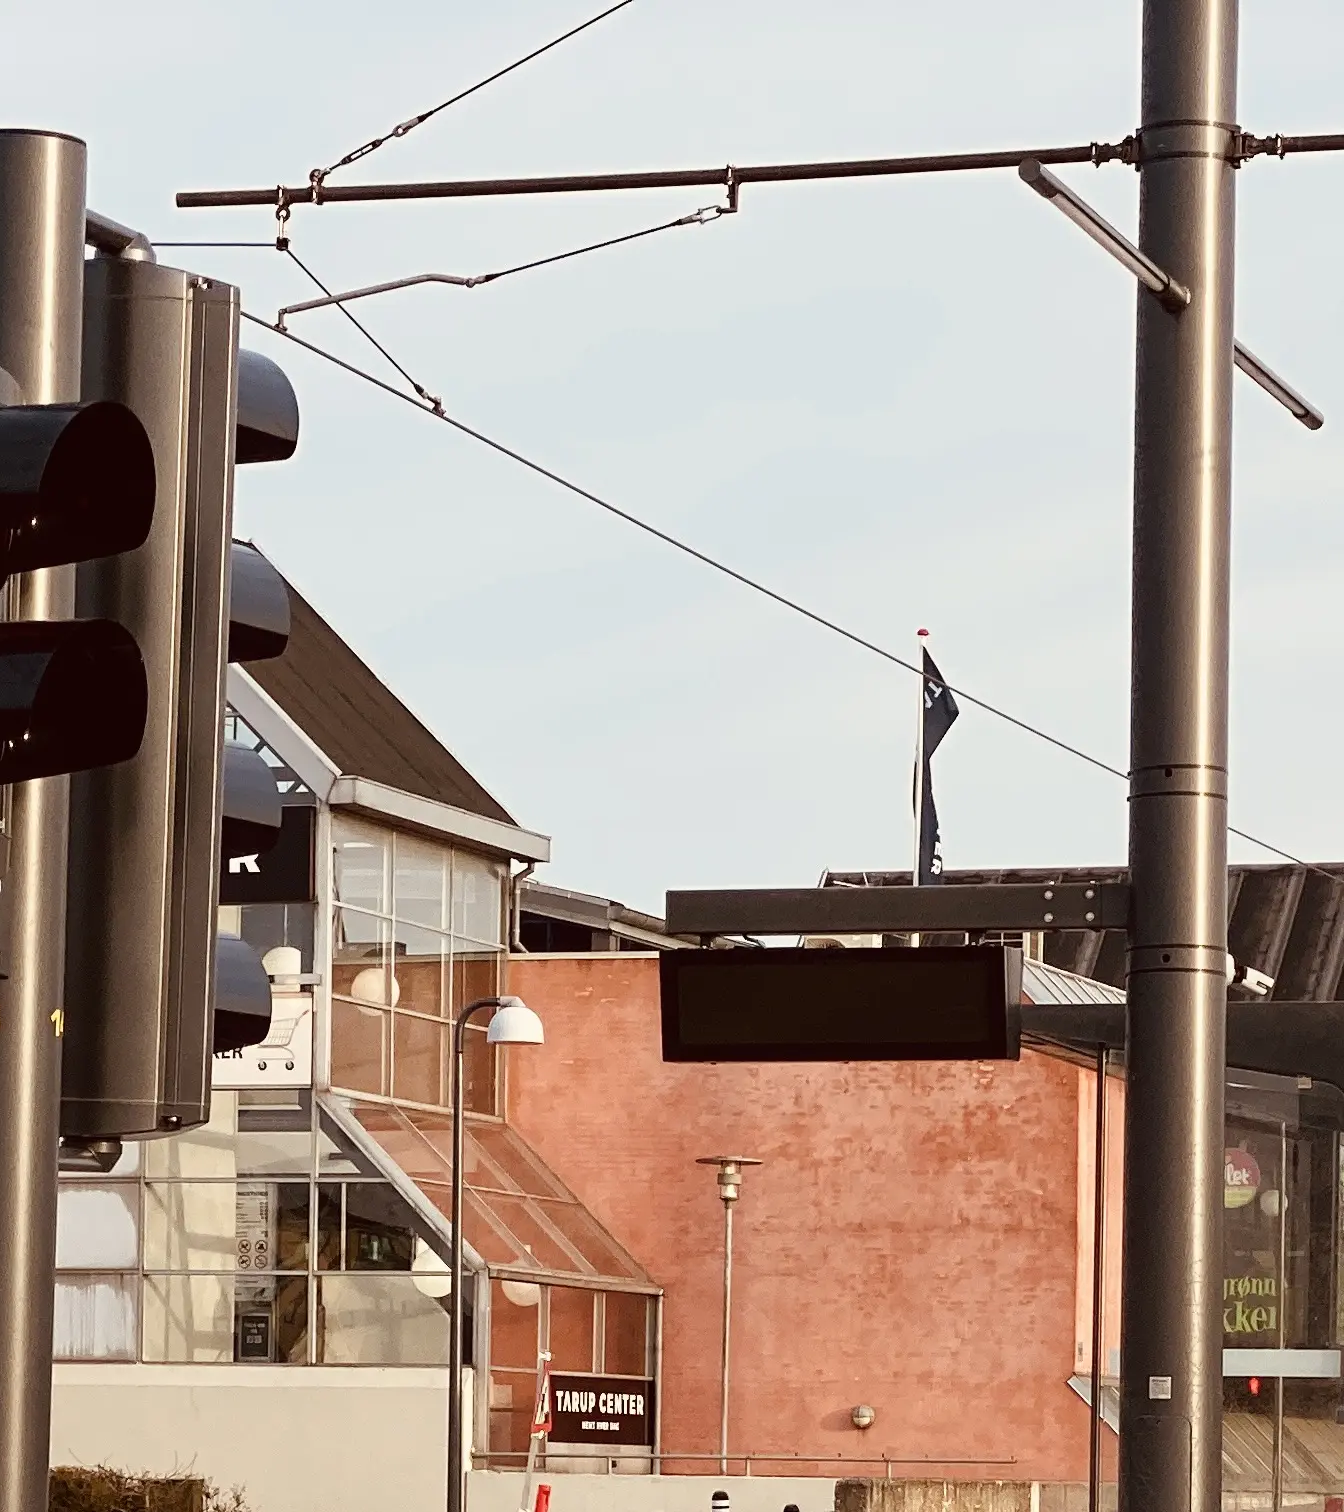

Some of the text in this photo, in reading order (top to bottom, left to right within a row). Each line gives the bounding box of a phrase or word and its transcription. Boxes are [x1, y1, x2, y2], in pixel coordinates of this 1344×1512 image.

[50, 1009, 64, 1037] 1
[556, 1390, 645, 1415] TARUP CENTER
